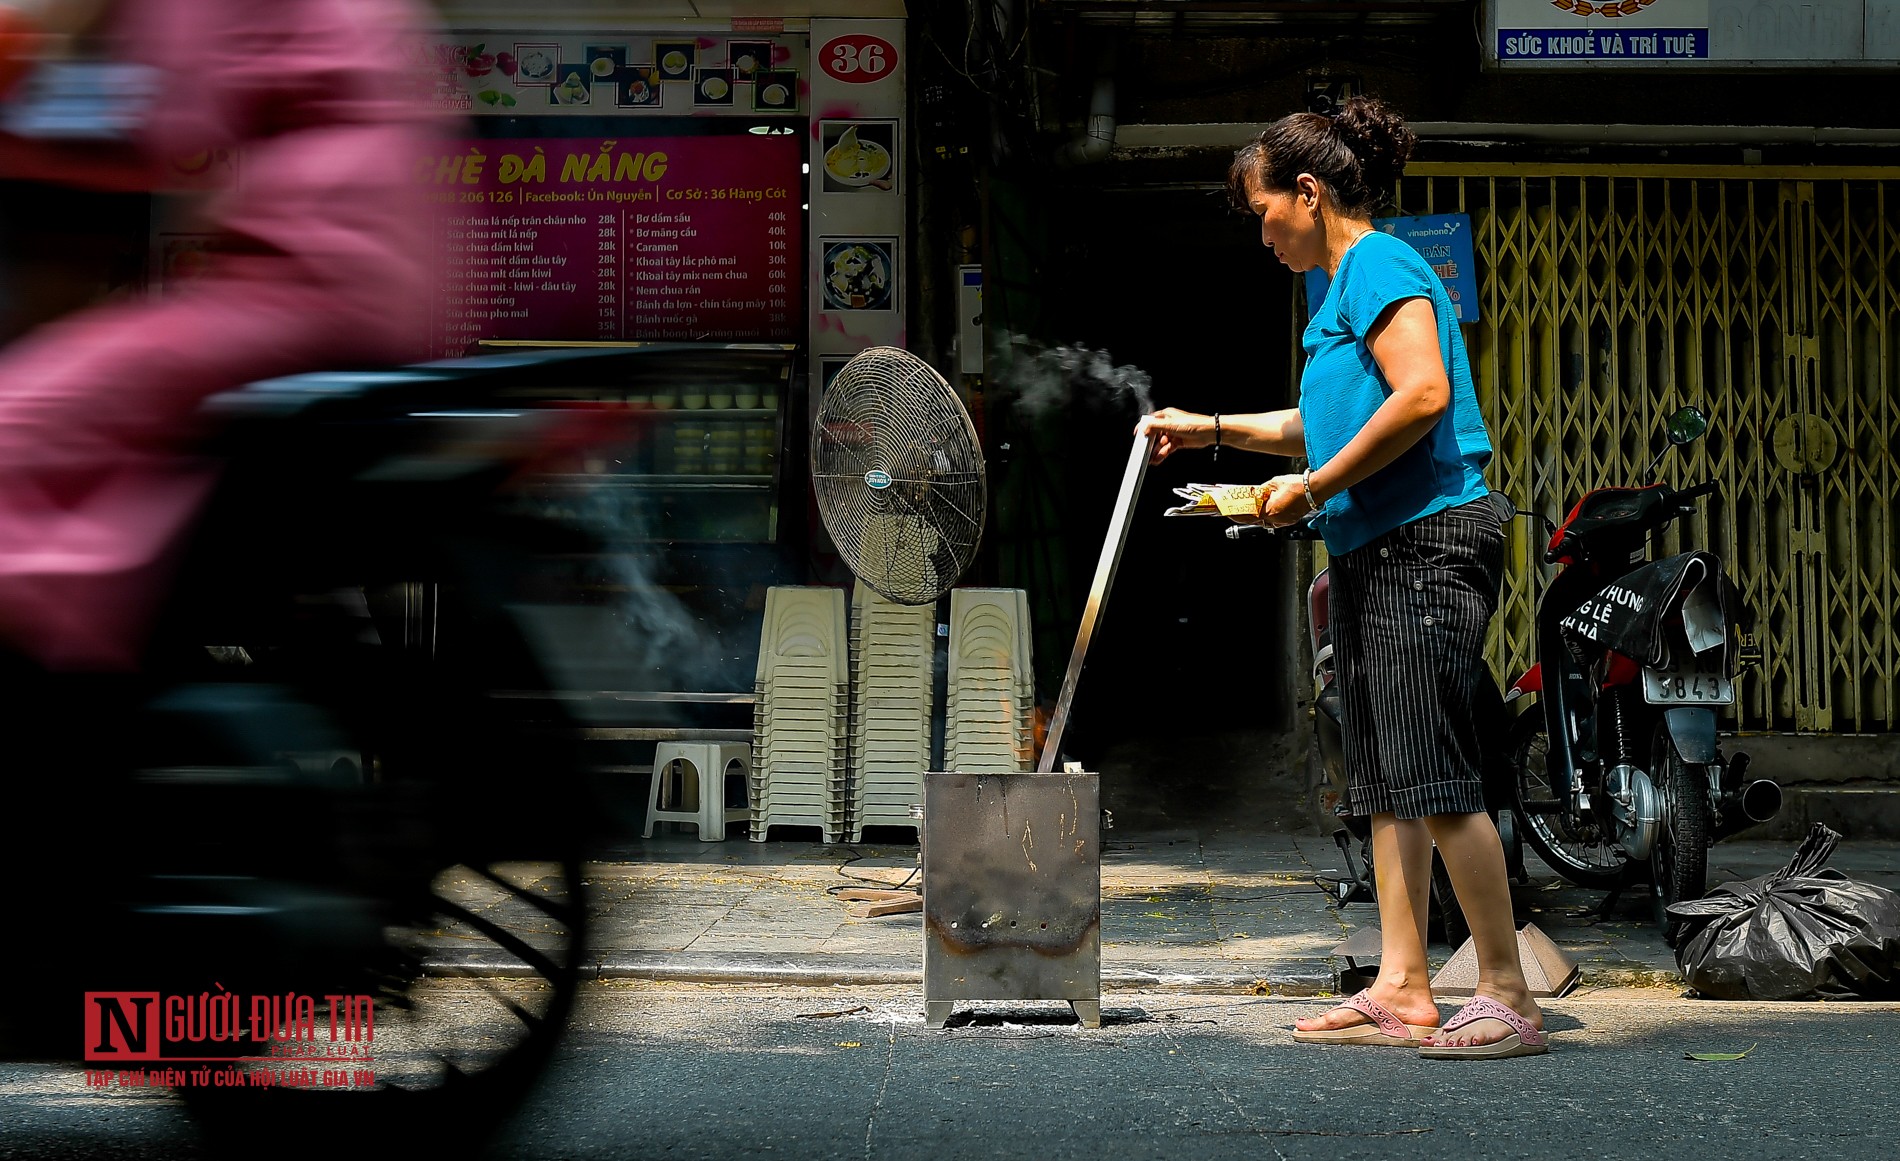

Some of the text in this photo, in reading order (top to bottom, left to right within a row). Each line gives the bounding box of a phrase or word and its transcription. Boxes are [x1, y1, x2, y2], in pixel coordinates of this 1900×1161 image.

[1505, 29, 1696, 57] SỨC KHOẺ VÀ TRÍ TUỆ
[831, 44, 886, 74] 36
[414, 139, 669, 185] CHÈ ĐÀ NẴNG
[459, 191, 484, 203] 206
[488, 191, 514, 202] 126
[525, 190, 584, 202] Facebook:
[666, 188, 683, 200] Cơ
[686, 186, 703, 200] Sở
[711, 188, 727, 200] 36
[729, 187, 763, 202] Hàng
[765, 186, 787, 199] Cót
[465, 215, 489, 226] chua
[491, 215, 500, 225] lá
[502, 214, 520, 228] nếp
[568, 214, 587, 224] nho
[598, 214, 616, 224] 28k
[768, 212, 786, 222] 40k
[465, 228, 489, 239] chua
[491, 229, 507, 239] mít
[509, 229, 518, 239] lá
[520, 227, 538, 240] nếp
[598, 228, 616, 238] 28k
[768, 226, 786, 236] 40k
[1407, 227, 1449, 238] vinaphone
[465, 241, 489, 252] chua
[514, 241, 534, 252] kiwi
[598, 241, 616, 251] 28k
[636, 241, 786, 252] Caramen 10k
[465, 255, 489, 265] chua
[491, 255, 507, 265] mít
[552, 254, 567, 267] tây
[598, 254, 616, 264] 28k
[636, 256, 663, 266] Khoai
[666, 255, 681, 268] tây
[718, 256, 737, 265] mai
[768, 255, 786, 265] 30k
[465, 268, 489, 278] chua
[531, 268, 552, 278] kiwi
[598, 268, 616, 277] 28k
[636, 270, 786, 283] Khoai tây mix nem chua 60k
[465, 281, 489, 292] chua
[490, 281, 507, 292] mít
[514, 281, 534, 291] kiwi
[561, 281, 577, 293] tây
[598, 281, 616, 291] 28k
[636, 286, 658, 295] Nem
[660, 285, 683, 295] chua
[768, 284, 786, 294] 60k
[465, 295, 489, 305] chua
[598, 294, 616, 304] 20k
[636, 300, 660, 309] Bánh
[662, 300, 675, 309] da
[769, 299, 786, 308] 10k
[465, 308, 489, 318] chua
[511, 308, 529, 318] mai
[598, 308, 616, 317] 15k
[636, 314, 661, 324] Bánh
[768, 314, 786, 322] 38k
[598, 321, 616, 331] 35k
[1592, 602, 1613, 625] LÊ
[1657, 677, 1721, 700] 3843
